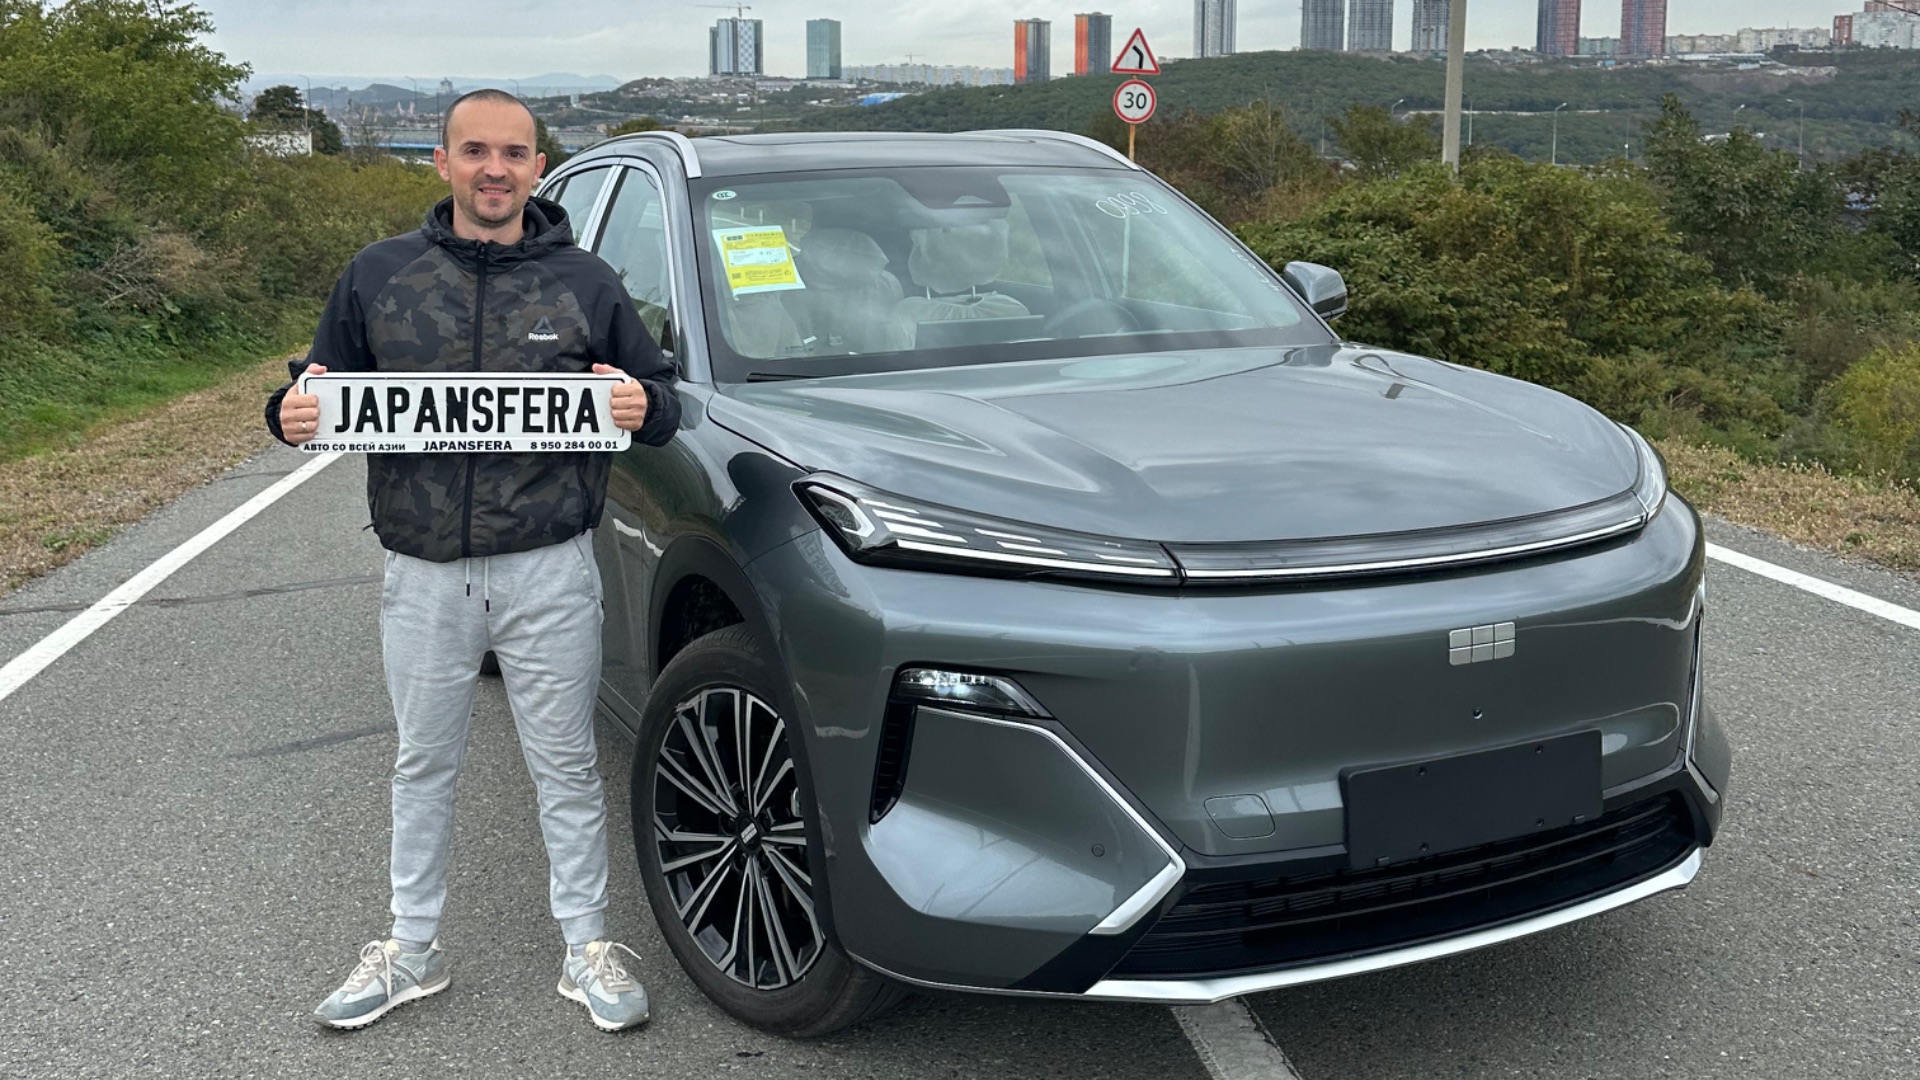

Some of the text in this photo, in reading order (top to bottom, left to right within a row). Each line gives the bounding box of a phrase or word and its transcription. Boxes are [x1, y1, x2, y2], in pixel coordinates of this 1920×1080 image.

[1123, 91, 1147, 110] 30
[528, 332, 559, 341] Reebok
[334, 385, 600, 433] JAPANSFERA
[303, 441, 406, 452] АВТО СО ВСЕЙ АЗИИ
[422, 440, 513, 451] JAPANSFERA
[530, 441, 618, 450] 8 950 284 00 01
